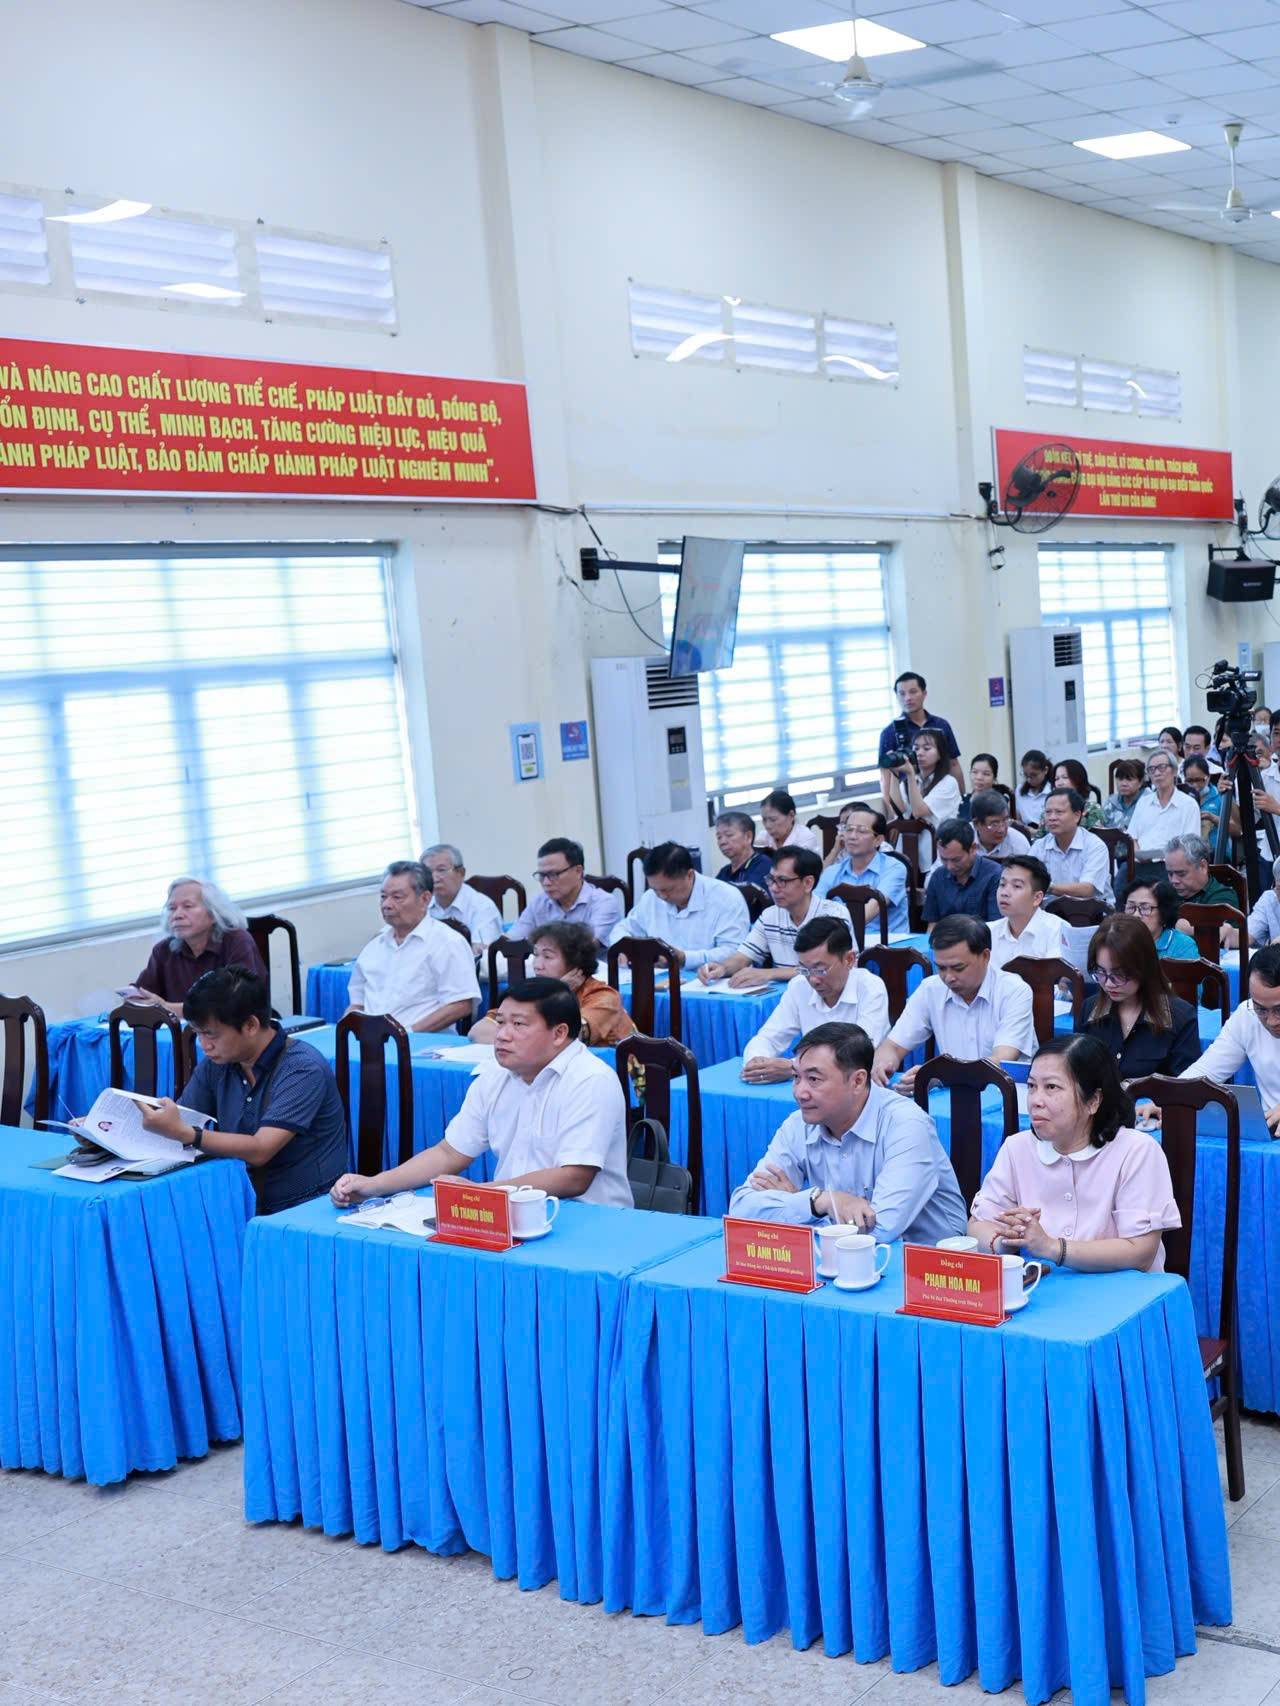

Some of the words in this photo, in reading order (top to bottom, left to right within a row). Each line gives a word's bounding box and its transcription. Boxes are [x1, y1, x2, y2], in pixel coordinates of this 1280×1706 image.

[27, 364, 82, 395] NÂNG
[86, 372, 122, 398] CAO
[127, 370, 171, 400] CHẤT
[176, 378, 231, 407] LƯỢNG
[234, 377, 264, 406] THỂ
[268, 382, 303, 411] CHẾ,
[306, 386, 345, 412] PHÁP
[349, 390, 383, 418] LUẬT
[416, 392, 440, 421] ĐỦ,
[480, 400, 502, 426] BỘ,
[32, 406, 84, 435] ĐỊNH,
[88, 409, 113, 438] CỤ
[117, 404, 156, 438] THỂ,
[160, 413, 206, 437] MINH
[209, 416, 258, 443] BẠCH.
[261, 416, 302, 442] TĂNG
[306, 418, 356, 445] CƯỜNG
[359, 422, 391, 450] HIỆU
[394, 427, 424, 452] LỰC,
[427, 427, 457, 455] HIỆU
[460, 426, 486, 453] QUẢ
[40, 441, 90, 468] PHÁP
[95, 443, 142, 475] LUẬT,
[146, 442, 181, 472] BẢO
[185, 443, 224, 473] ĐẢM
[228, 446, 270, 474] CHẤP
[274, 451, 316, 476] HÀNH
[319, 453, 358, 477] PHÁP
[361, 454, 395, 482] LUẬT
[399, 457, 451, 481] NGHIÊM
[758, 1246, 771, 1260] ANH
[773, 1245, 791, 1263] TUẤN
[925, 1272, 946, 1291] PHẠM
[949, 1276, 964, 1291] HOA
[966, 1278, 980, 1293] MAI
